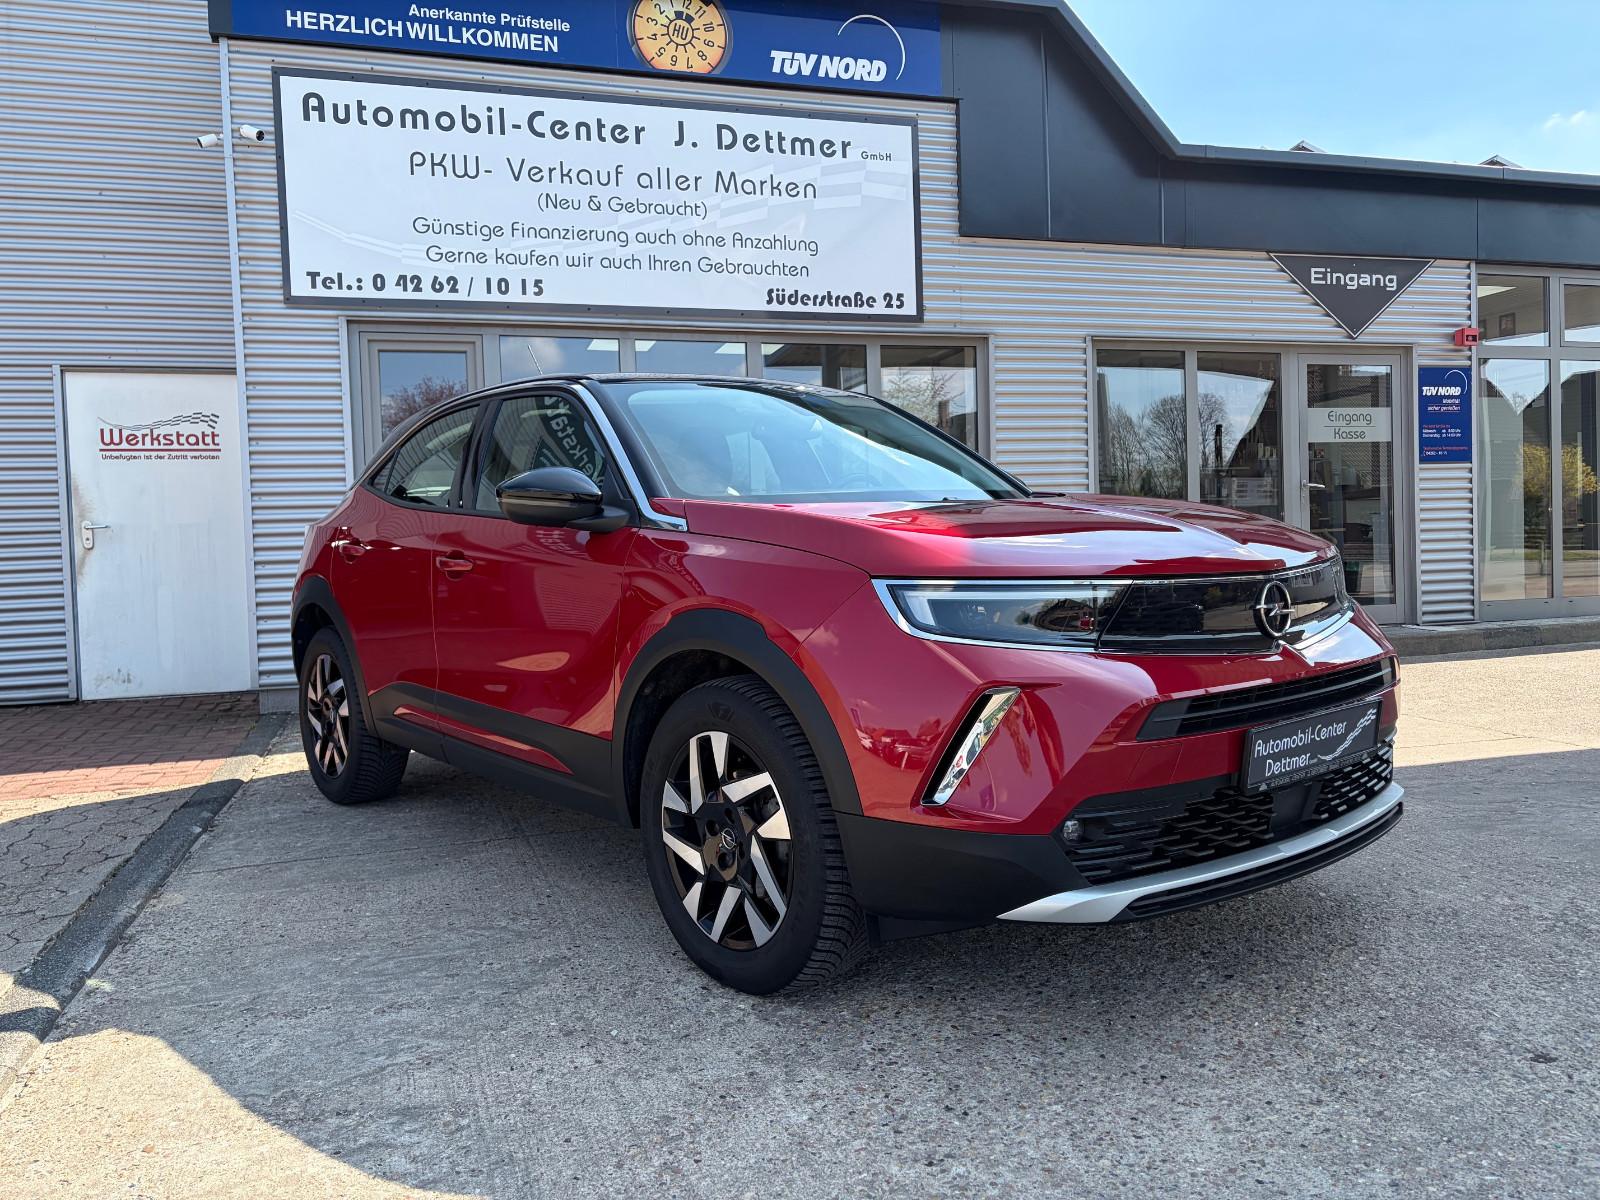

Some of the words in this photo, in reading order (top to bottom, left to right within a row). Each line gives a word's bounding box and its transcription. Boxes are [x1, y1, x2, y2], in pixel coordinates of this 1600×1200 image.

[408, 4, 497, 25] Anerkannte
[500, 13, 571, 32] Prüfstelle
[654, 3, 665, 15] 2
[694, 6, 706, 19] 11
[646, 17, 658, 26] 3
[702, 21, 715, 33] 10
[286, 9, 403, 38] HERZLICH
[406, 21, 559, 53] WILLKOMMEN
[647, 33, 658, 41] 4
[672, 23, 689, 41] HU
[655, 47, 666, 57] 5
[703, 39, 715, 48] 9
[670, 55, 678, 66] 6
[686, 57, 693, 69] 7
[697, 50, 707, 61] 8
[770, 50, 819, 76] TÜV
[817, 55, 887, 82] NORD
[302, 92, 645, 145] Automobil-Center
[674, 120, 698, 148] J.
[716, 123, 851, 158] Dettmer
[860, 151, 892, 162] GmbH
[410, 151, 493, 179] PKW-
[506, 157, 624, 187] Verkauf
[637, 167, 702, 192] aller
[715, 170, 817, 199] Marken
[537, 193, 581, 212] (Neu
[587, 195, 602, 212] &
[608, 196, 708, 220] Gebraucht)
[412, 217, 504, 241] Günstige
[511, 222, 629, 247] Finanzierung
[635, 229, 676, 246] auch
[682, 230, 726, 248] ohne
[732, 232, 819, 256] Anzahlung
[425, 245, 488, 264] Gerne
[495, 248, 559, 267] kaufen
[566, 253, 594, 268] wir
[600, 253, 642, 270] auch
[648, 254, 692, 272] Ihren
[698, 257, 809, 277] Gebrauchten
[306, 271, 363, 291] Tel.:
[372, 273, 386, 292] 0
[395, 274, 423, 293] 42
[431, 275, 459, 294] 62
[467, 276, 474, 297] /
[485, 277, 510, 296] 10
[521, 278, 544, 296] 15
[1310, 267, 1397, 291] Eingang
[766, 288, 877, 308] Süderstraße
[883, 292, 905, 309] 25
[1422, 386, 1439, 396] TÜV
[1437, 386, 1461, 396] NORD
[1327, 410, 1372, 426] Eingang
[100, 428, 220, 446] Werkstatt
[1334, 428, 1366, 440] Kasse
[101, 453, 141, 461] Unbefugten
[1254, 721, 1347, 758] Automobil-Center
[1265, 753, 1311, 777] Dettmer
